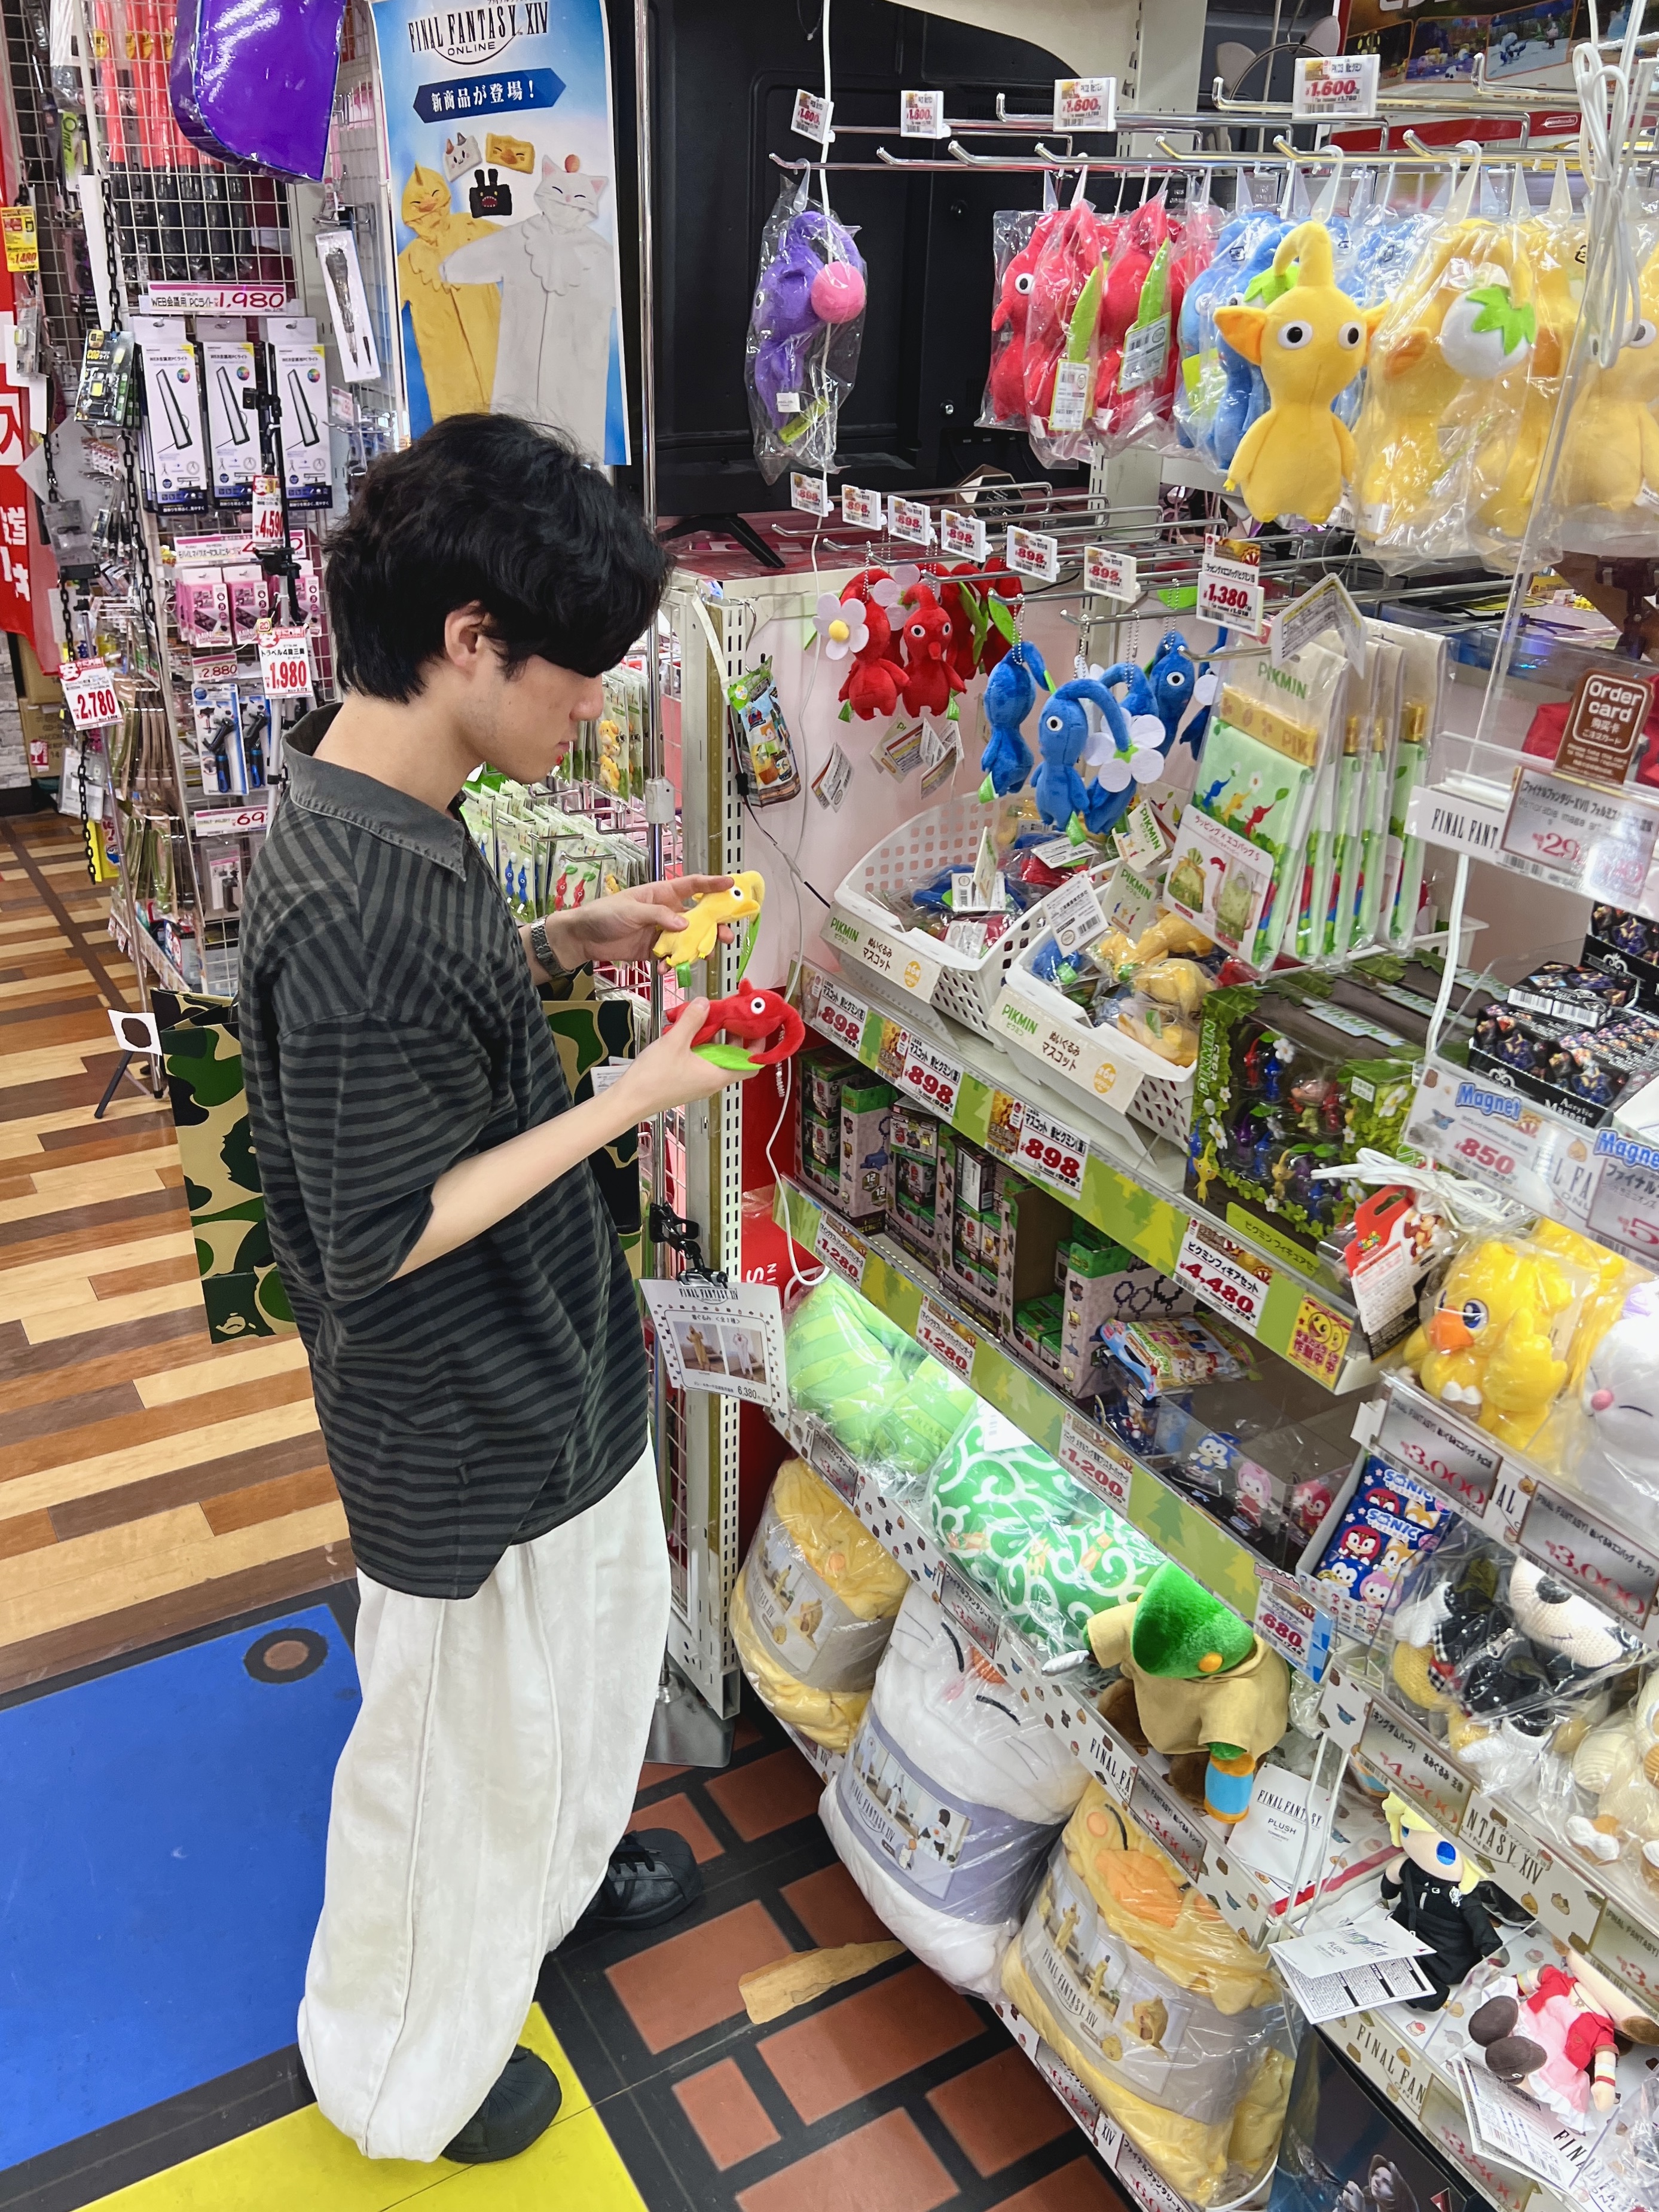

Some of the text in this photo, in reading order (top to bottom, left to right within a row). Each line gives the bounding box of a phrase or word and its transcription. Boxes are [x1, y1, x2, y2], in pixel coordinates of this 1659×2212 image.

[408, 2, 549, 53] FINAL FANTASY XIV
[447, 41, 496, 56] ONLINE
[431, 80, 534, 112] 新商品が登場!
[219, 292, 285, 308] 1,980
[201, 664, 237, 678] 2,880
[270, 660, 307, 689] 1,980
[1258, 662, 1307, 699] PIKMIN
[77, 689, 115, 720] 2,780
[1589, 681, 1642, 706] Order
[1588, 700, 1633, 723] card
[1282, 730, 1318, 763] PIK
[1139, 807, 1161, 850] PIKMIN
[1431, 808, 1464, 839] FINAL
[1120, 868, 1153, 900] PIKMIN
[830, 917, 859, 943] PIKMIN
[863, 947, 891, 972] マスコット
[867, 937, 892, 958] ぬいぐるみ
[1001, 1003, 1038, 1035] PIKMIN
[909, 1042, 928, 1062] マスコット
[1042, 1041, 1077, 1072] マスコット
[1049, 1030, 1080, 1057] ぬいぐるみ
[1197, 1018, 1217, 1096] PIKMIN
[1455, 1082, 1522, 1121] Magnet
[1544, 1098, 1587, 1125] Magnet
[1025, 1112, 1048, 1134] マスコット
[866, 1173, 877, 1184] 12
[679, 1287, 739, 1301] FINAL FANTASY XIV
[1383, 1468, 1434, 1502] SONIC
[1366, 1508, 1424, 1541] SONIC
[1090, 1737, 1116, 1778] FINAL
[862, 1798, 885, 1832] FANTASY
[1257, 1789, 1322, 1826] FINAL FANTSY
[1267, 1818, 1297, 1835] PLUSH
[1466, 1808, 1544, 1886] NTASY XIV
[1327, 1941, 1348, 1956] PLUSH
[1043, 1948, 1058, 1980] FINAL
[1057, 1973, 1086, 2018] FANTASY
[1084, 2009, 1099, 2029] XIV
[1356, 2023, 1426, 2104] FINAL FAN
[1101, 2122, 1116, 2146] XIV
